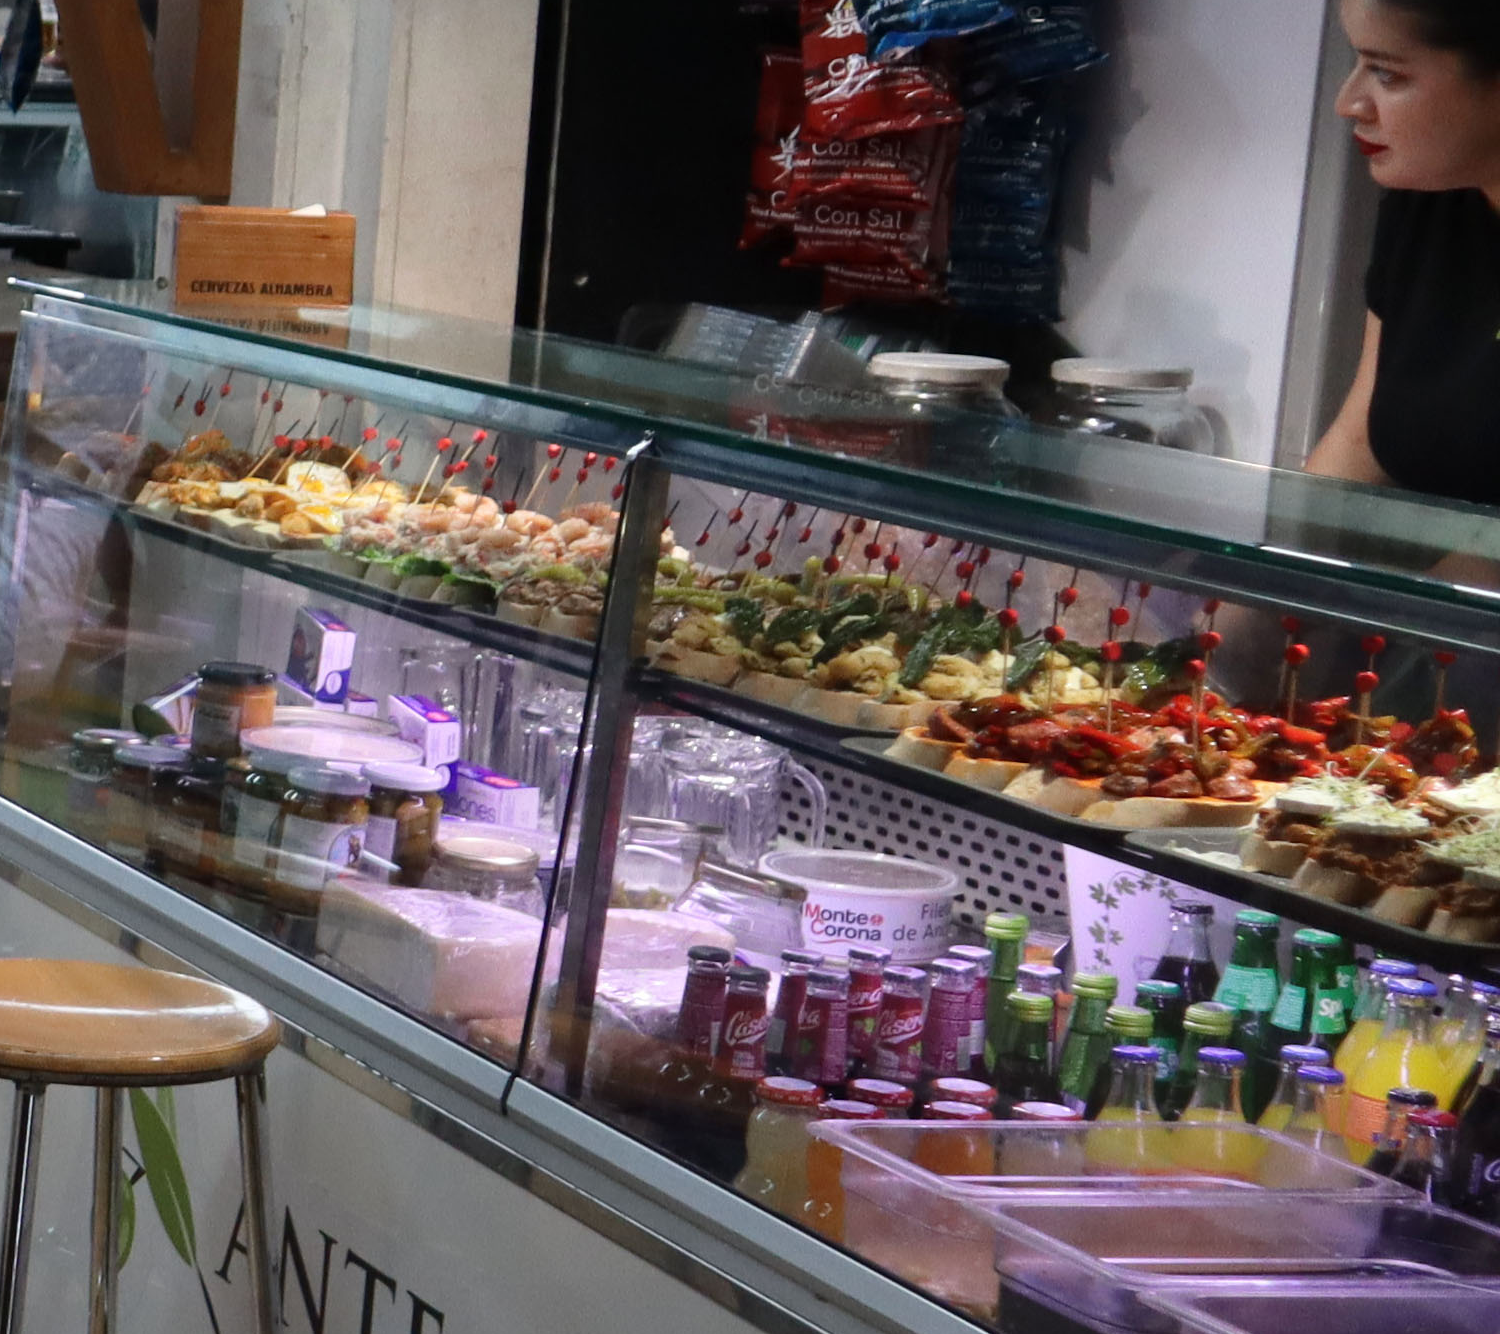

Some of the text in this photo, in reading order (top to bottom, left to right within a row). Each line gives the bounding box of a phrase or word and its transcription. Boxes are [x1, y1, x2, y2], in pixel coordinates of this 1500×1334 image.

[867, 138, 901, 157] Sal
[815, 204, 860, 225] Con
[867, 208, 902, 229] Sal
[190, 279, 333, 297] CERVEZAS ALHAMBRA
[804, 902, 869, 925] Monte
[811, 918, 882, 942] Corona
[893, 924, 917, 942] de
